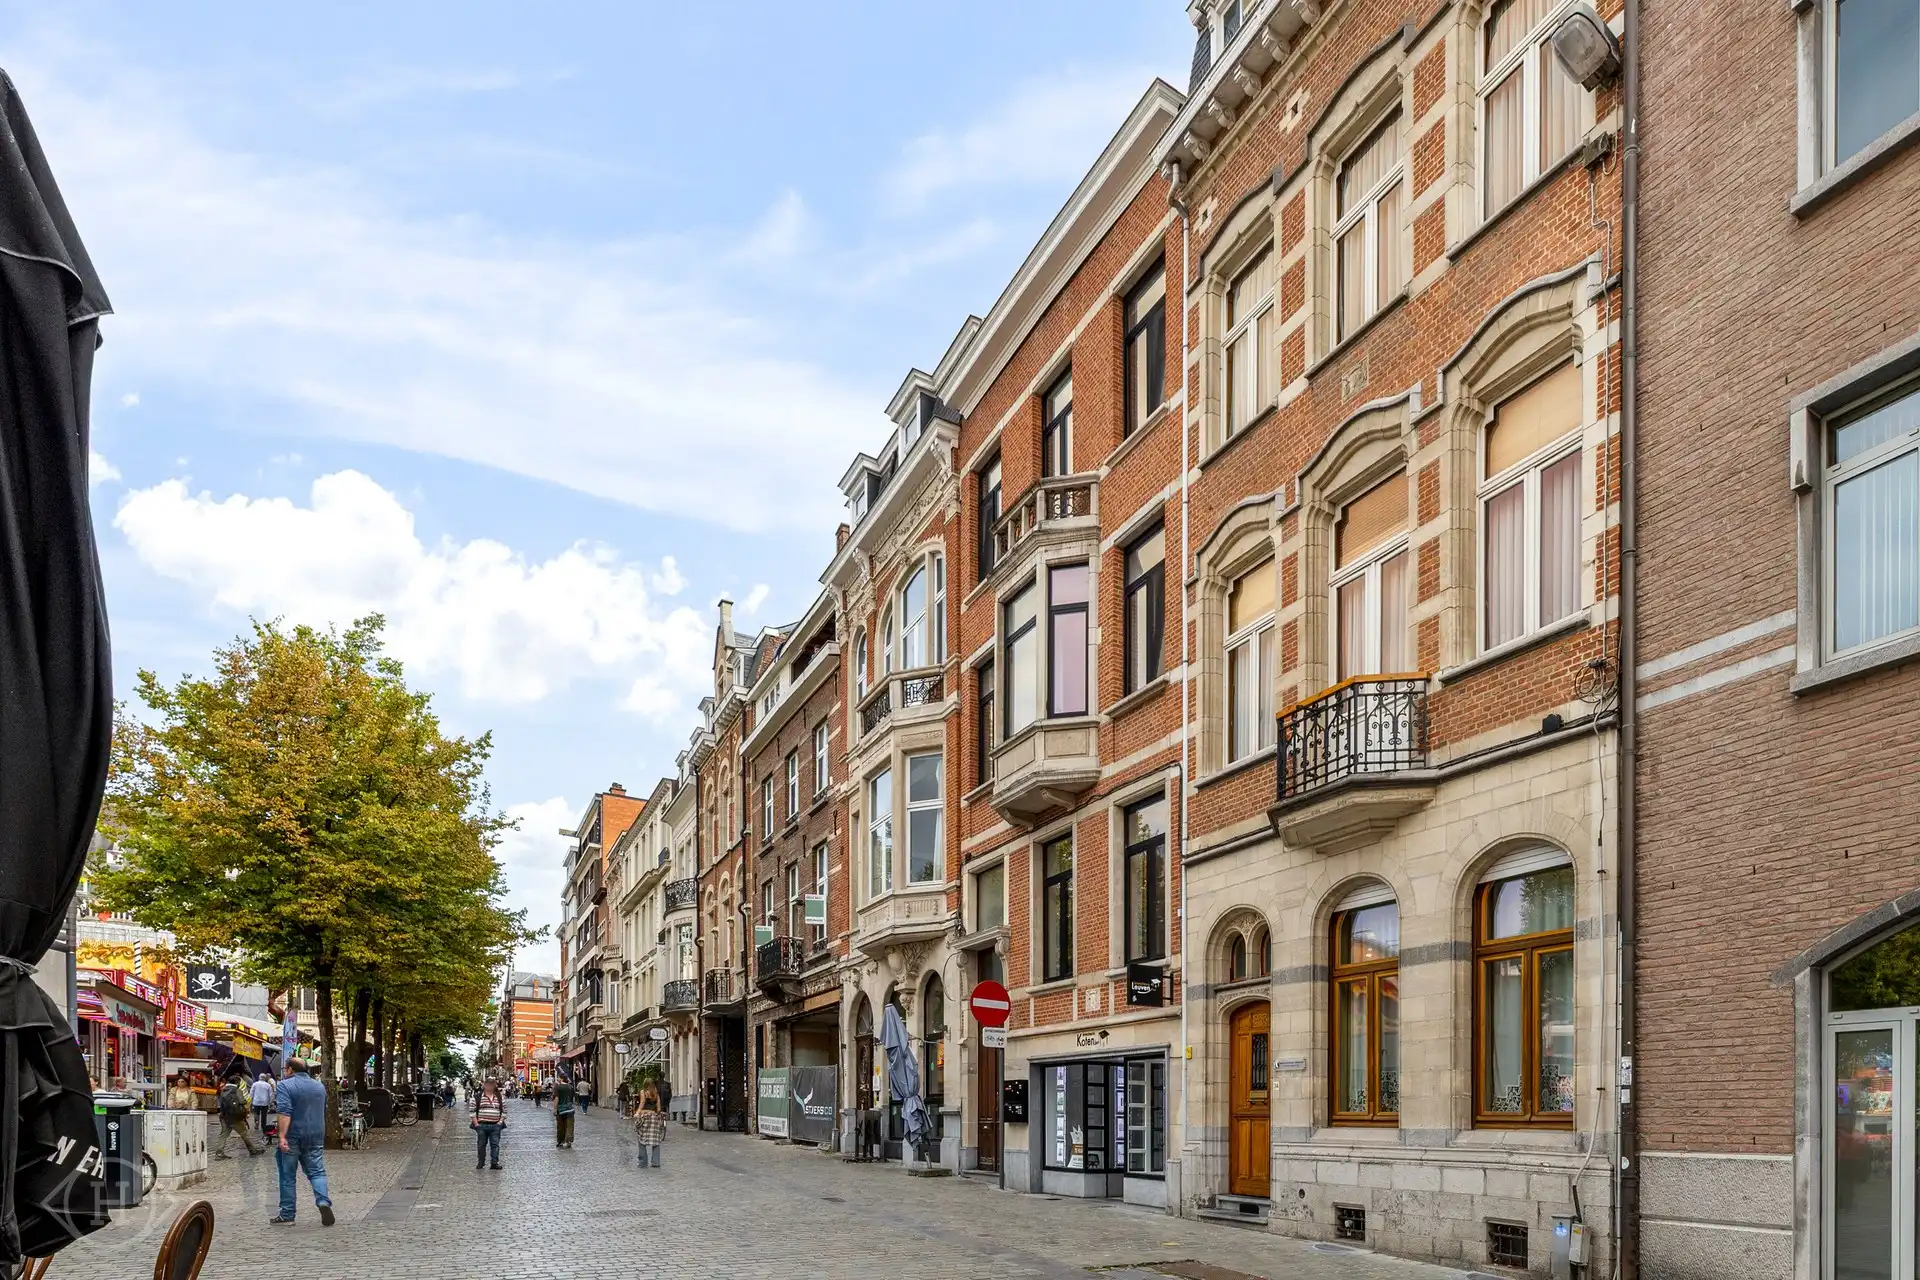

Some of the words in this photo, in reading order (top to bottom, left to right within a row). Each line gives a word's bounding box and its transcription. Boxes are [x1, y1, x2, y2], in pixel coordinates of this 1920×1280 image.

[1131, 981, 1151, 991] Leuven
[1076, 1033, 1097, 1047] Koten
[109, 1131, 117, 1151] leuven
